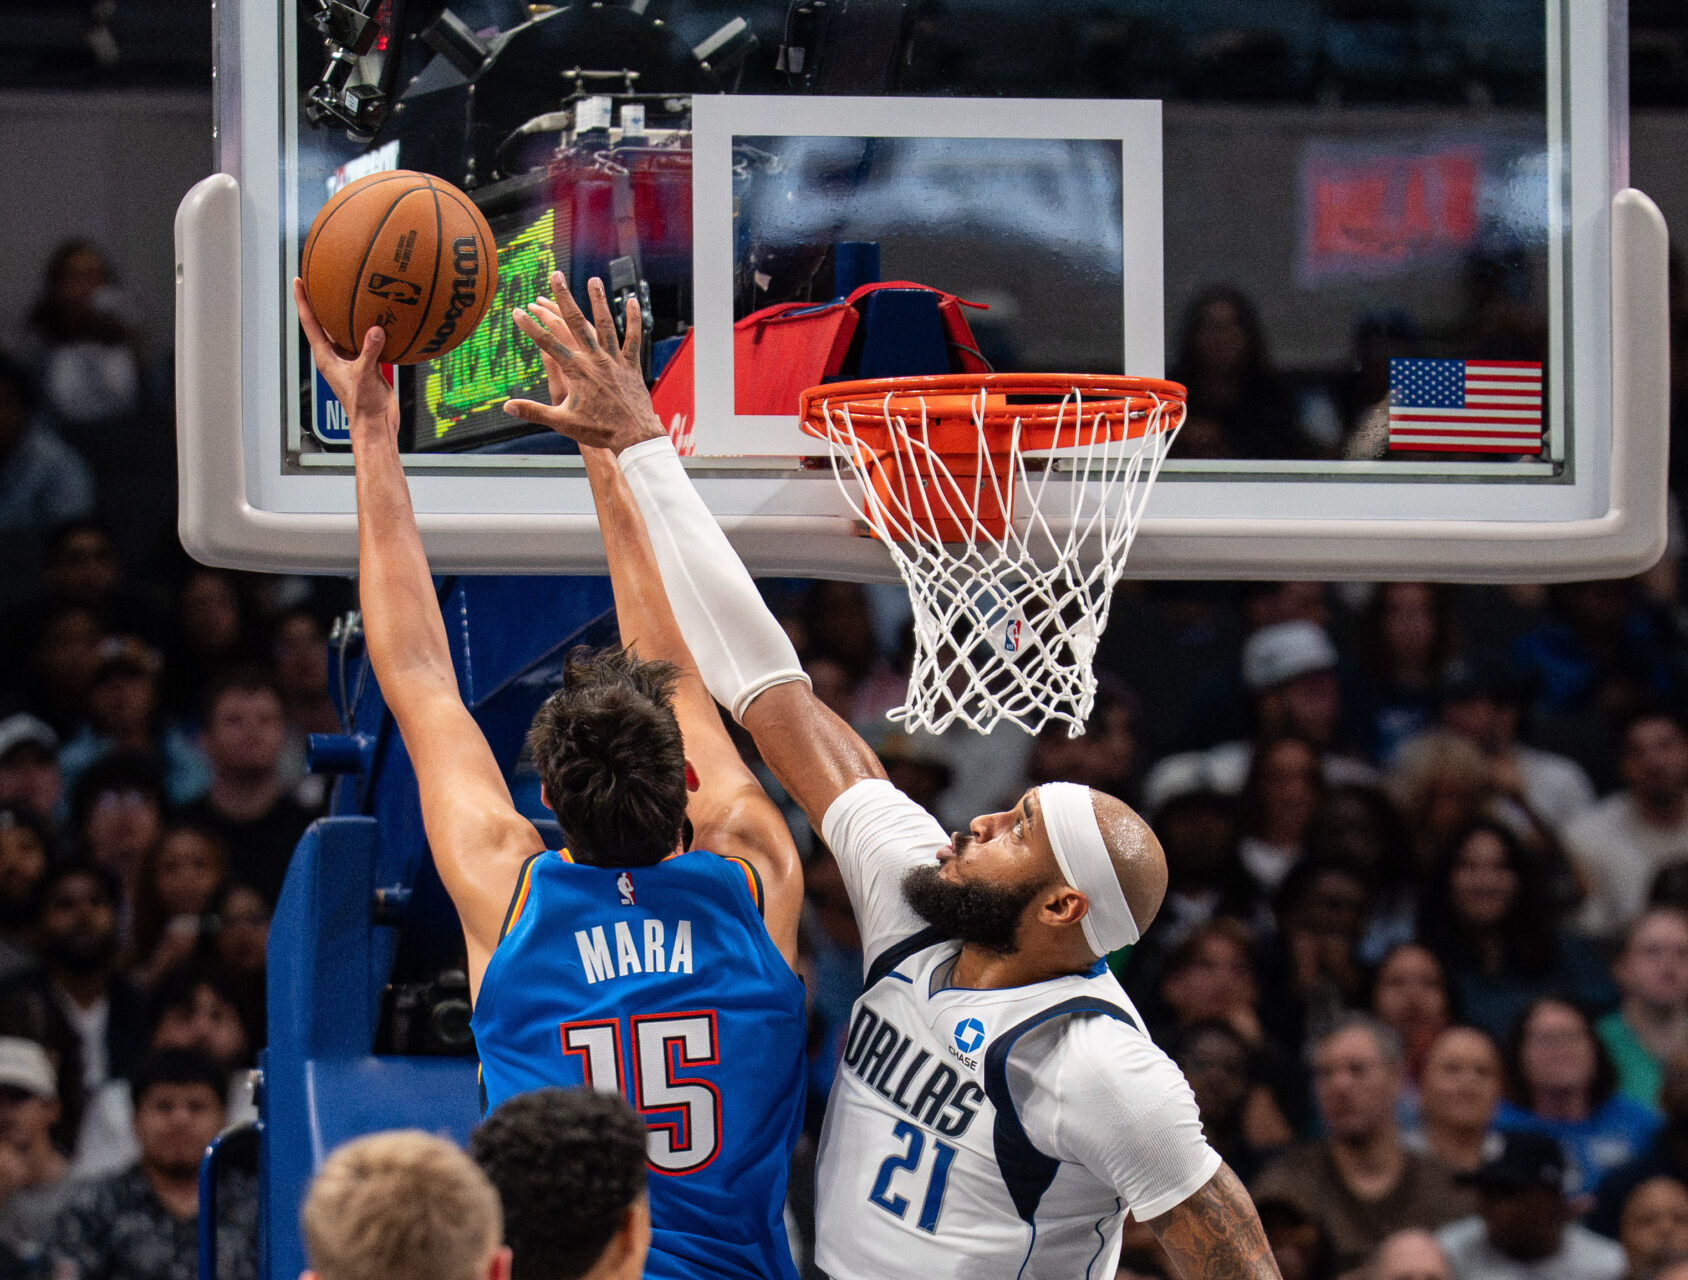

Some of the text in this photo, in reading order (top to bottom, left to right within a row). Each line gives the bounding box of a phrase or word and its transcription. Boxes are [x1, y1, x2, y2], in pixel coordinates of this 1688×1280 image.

[416, 233, 480, 354] Wilson
[574, 918, 693, 984] MARA
[559, 1009, 722, 1177] 15
[844, 1002, 986, 1139] DALLAS
[948, 1045, 977, 1071] CHASE
[867, 1118, 959, 1235] 21
